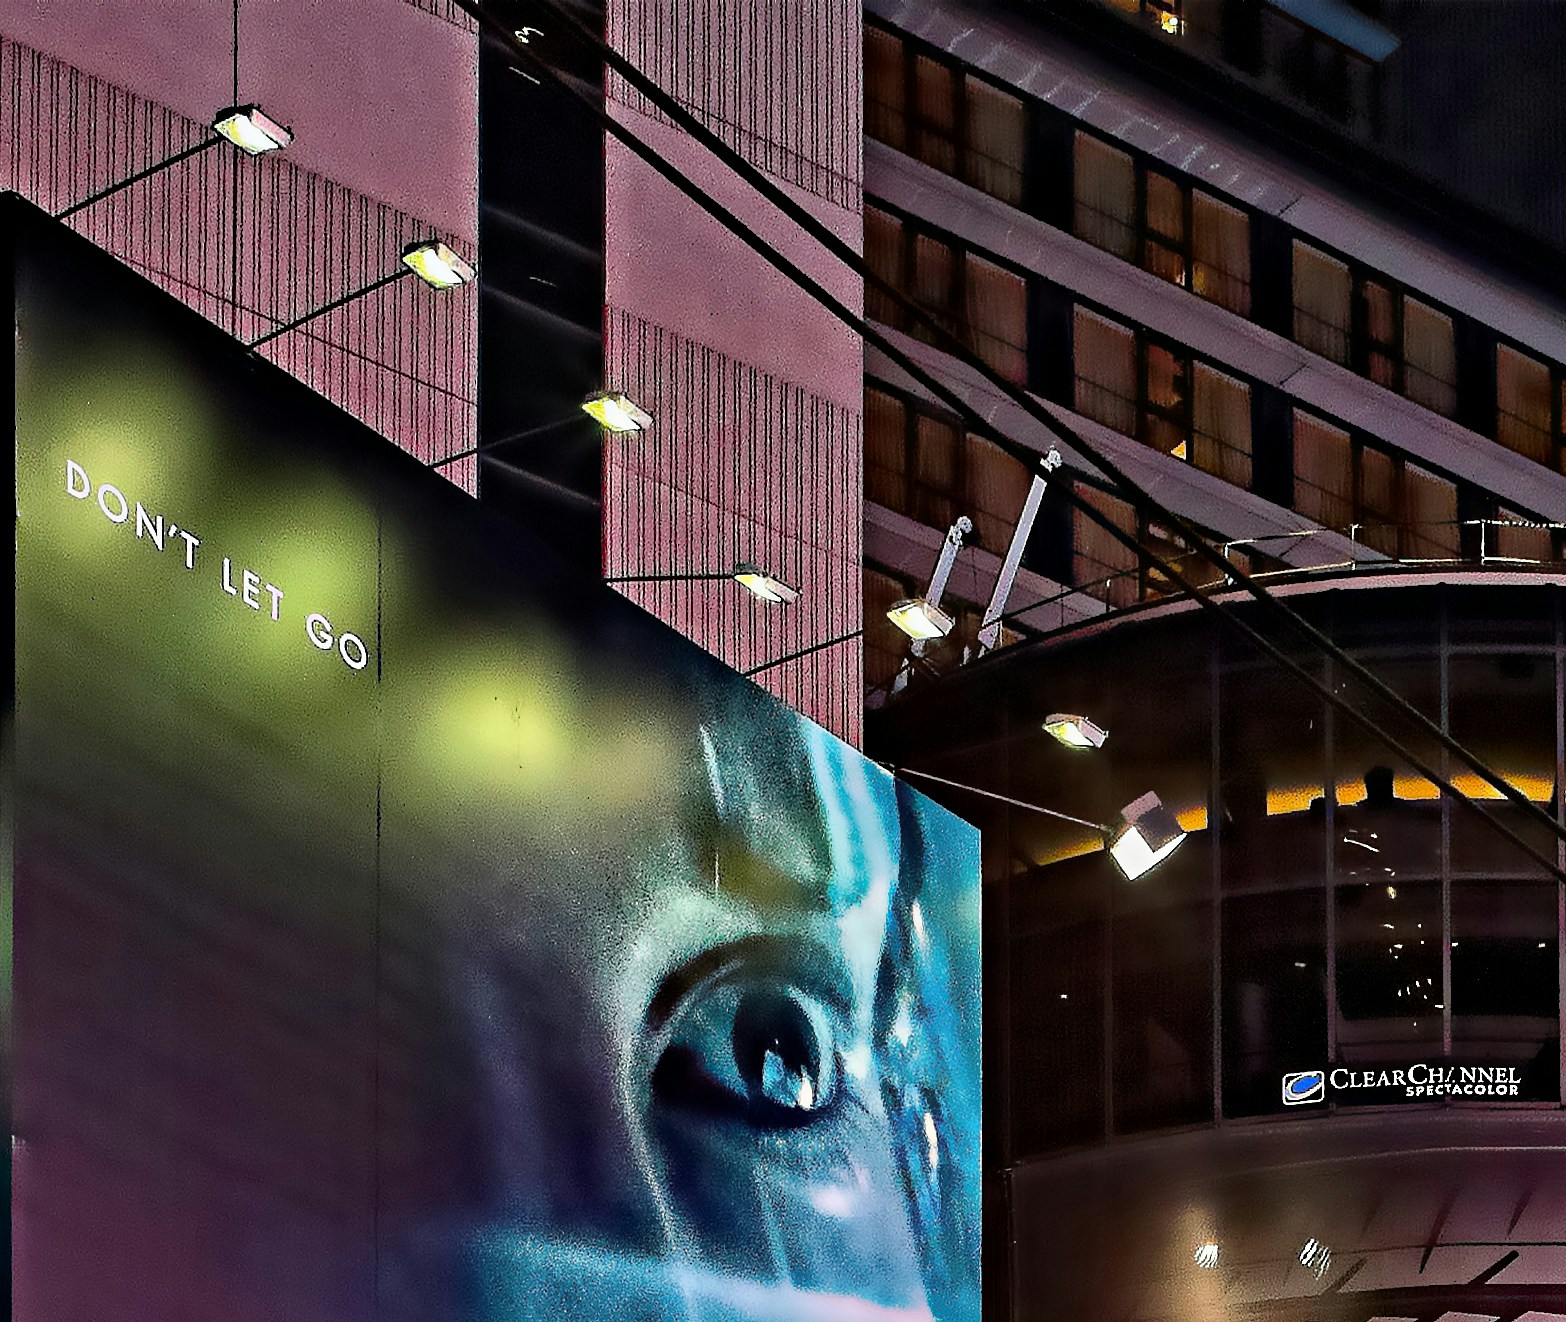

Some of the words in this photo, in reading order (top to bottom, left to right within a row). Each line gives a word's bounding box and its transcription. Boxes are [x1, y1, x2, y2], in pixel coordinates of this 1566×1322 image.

[66, 459, 200, 570] DON'T
[221, 557, 284, 621] LET
[305, 612, 369, 671] GO
[1405, 1083, 1519, 1097] SPECTACOLOR
